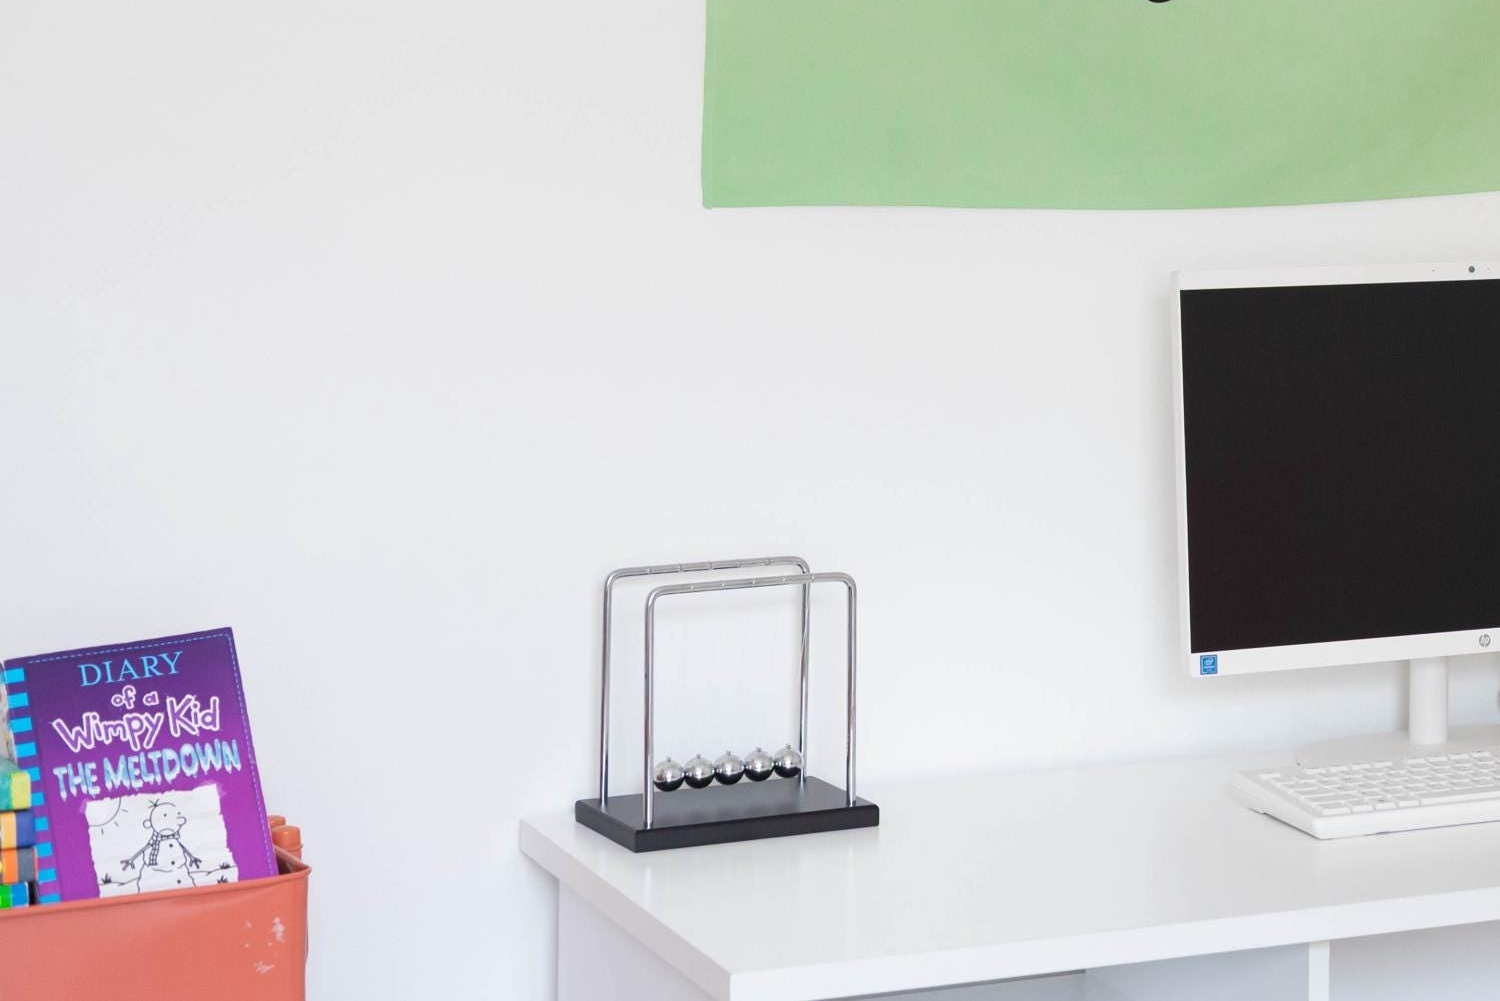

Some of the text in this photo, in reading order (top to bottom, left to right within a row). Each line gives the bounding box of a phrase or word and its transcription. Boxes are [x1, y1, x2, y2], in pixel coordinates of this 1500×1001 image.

[77, 651, 183, 687] DIARY
[111, 685, 159, 709] of a
[52, 694, 219, 752] Wimpy Kid
[53, 739, 241, 799] THE MELTDOWN
